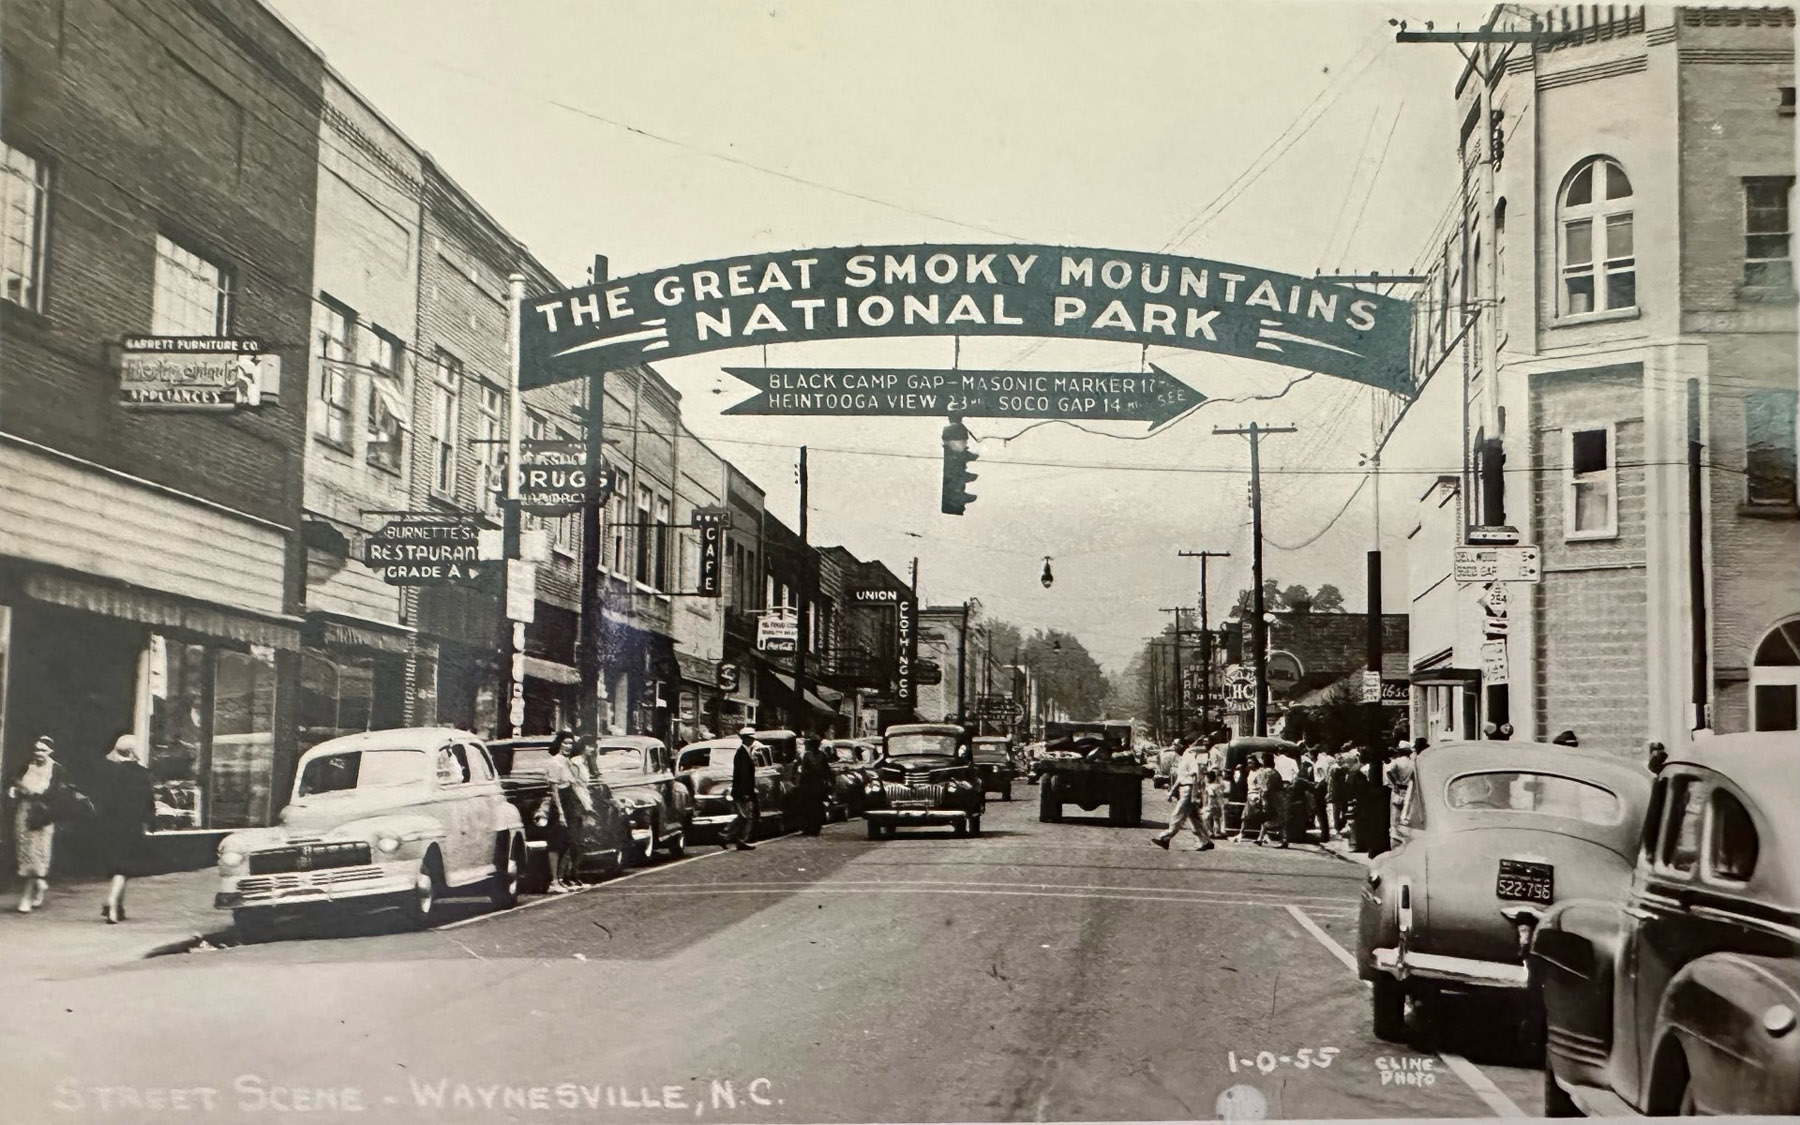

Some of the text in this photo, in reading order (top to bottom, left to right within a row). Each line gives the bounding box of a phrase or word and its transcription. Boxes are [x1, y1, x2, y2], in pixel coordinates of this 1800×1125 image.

[536, 252, 1378, 334] THE GREAT SMOKY MOUNTAINS
[695, 293, 1222, 341] NATIONAL PARK
[126, 339, 173, 350] GARRETT
[177, 339, 239, 350] FURNITURE
[769, 374, 837, 389] BLACK
[843, 374, 898, 389] CAMP
[1054, 377, 1135, 393] MARKER
[769, 393, 879, 409] HEINTOOGA
[888, 394, 937, 409] VIEW
[999, 396, 1049, 412] SOCO
[1058, 397, 1096, 413] GAP
[1104, 398, 1121, 413] 14
[370, 544, 478, 561] RESTAURAN
[705, 527, 715, 591] CAFE
[387, 564, 461, 578] GRADE A
[856, 590, 897, 600] UNION
[899, 601, 910, 675] CLOTHING
